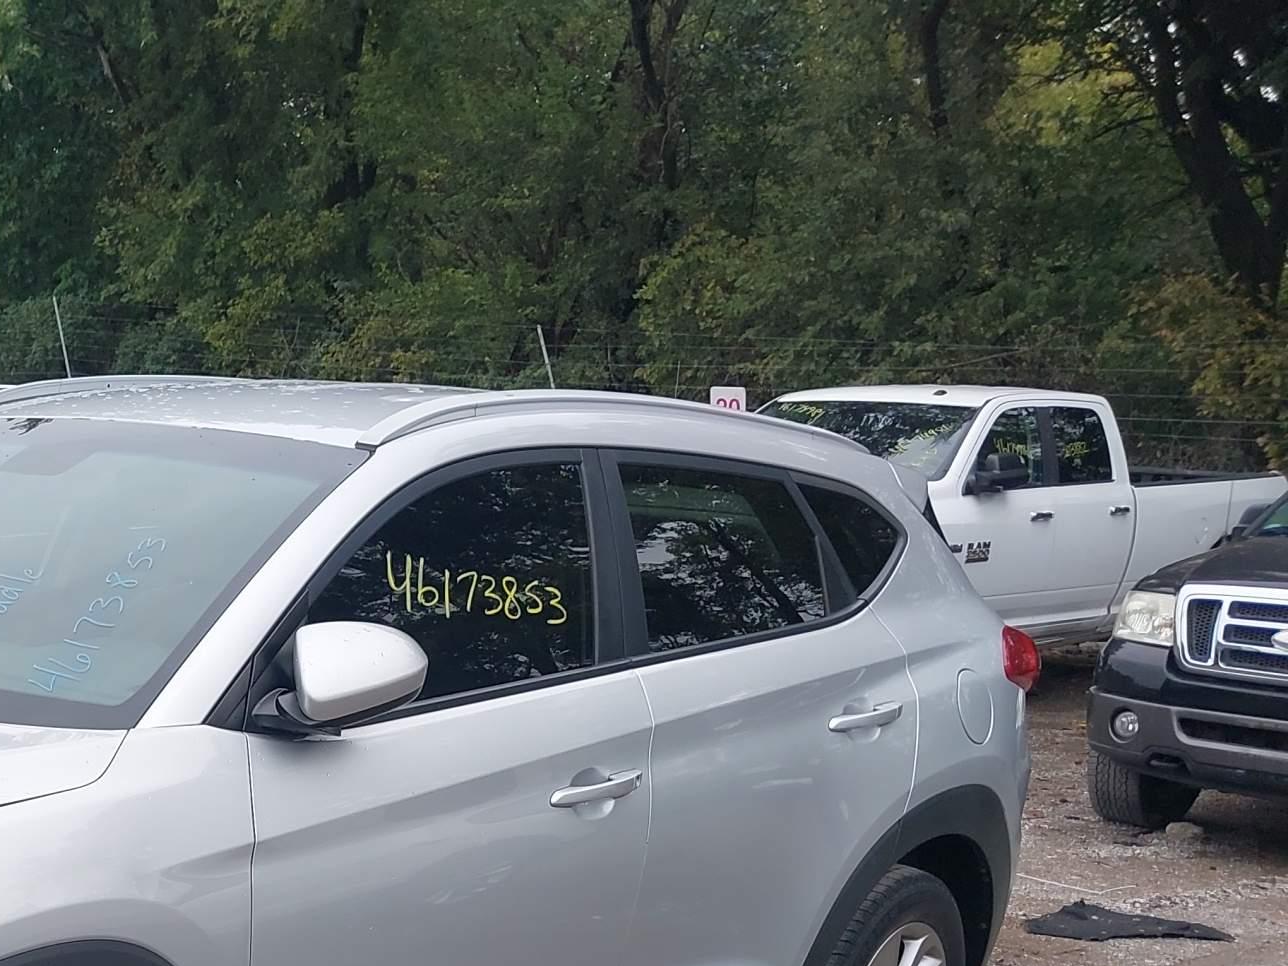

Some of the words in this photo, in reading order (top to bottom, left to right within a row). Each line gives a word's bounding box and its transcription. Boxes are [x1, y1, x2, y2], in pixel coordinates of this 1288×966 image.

[967, 541, 991, 550] RAM
[28, 535, 166, 692] 46173853
[386, 550, 568, 625] 46173853
